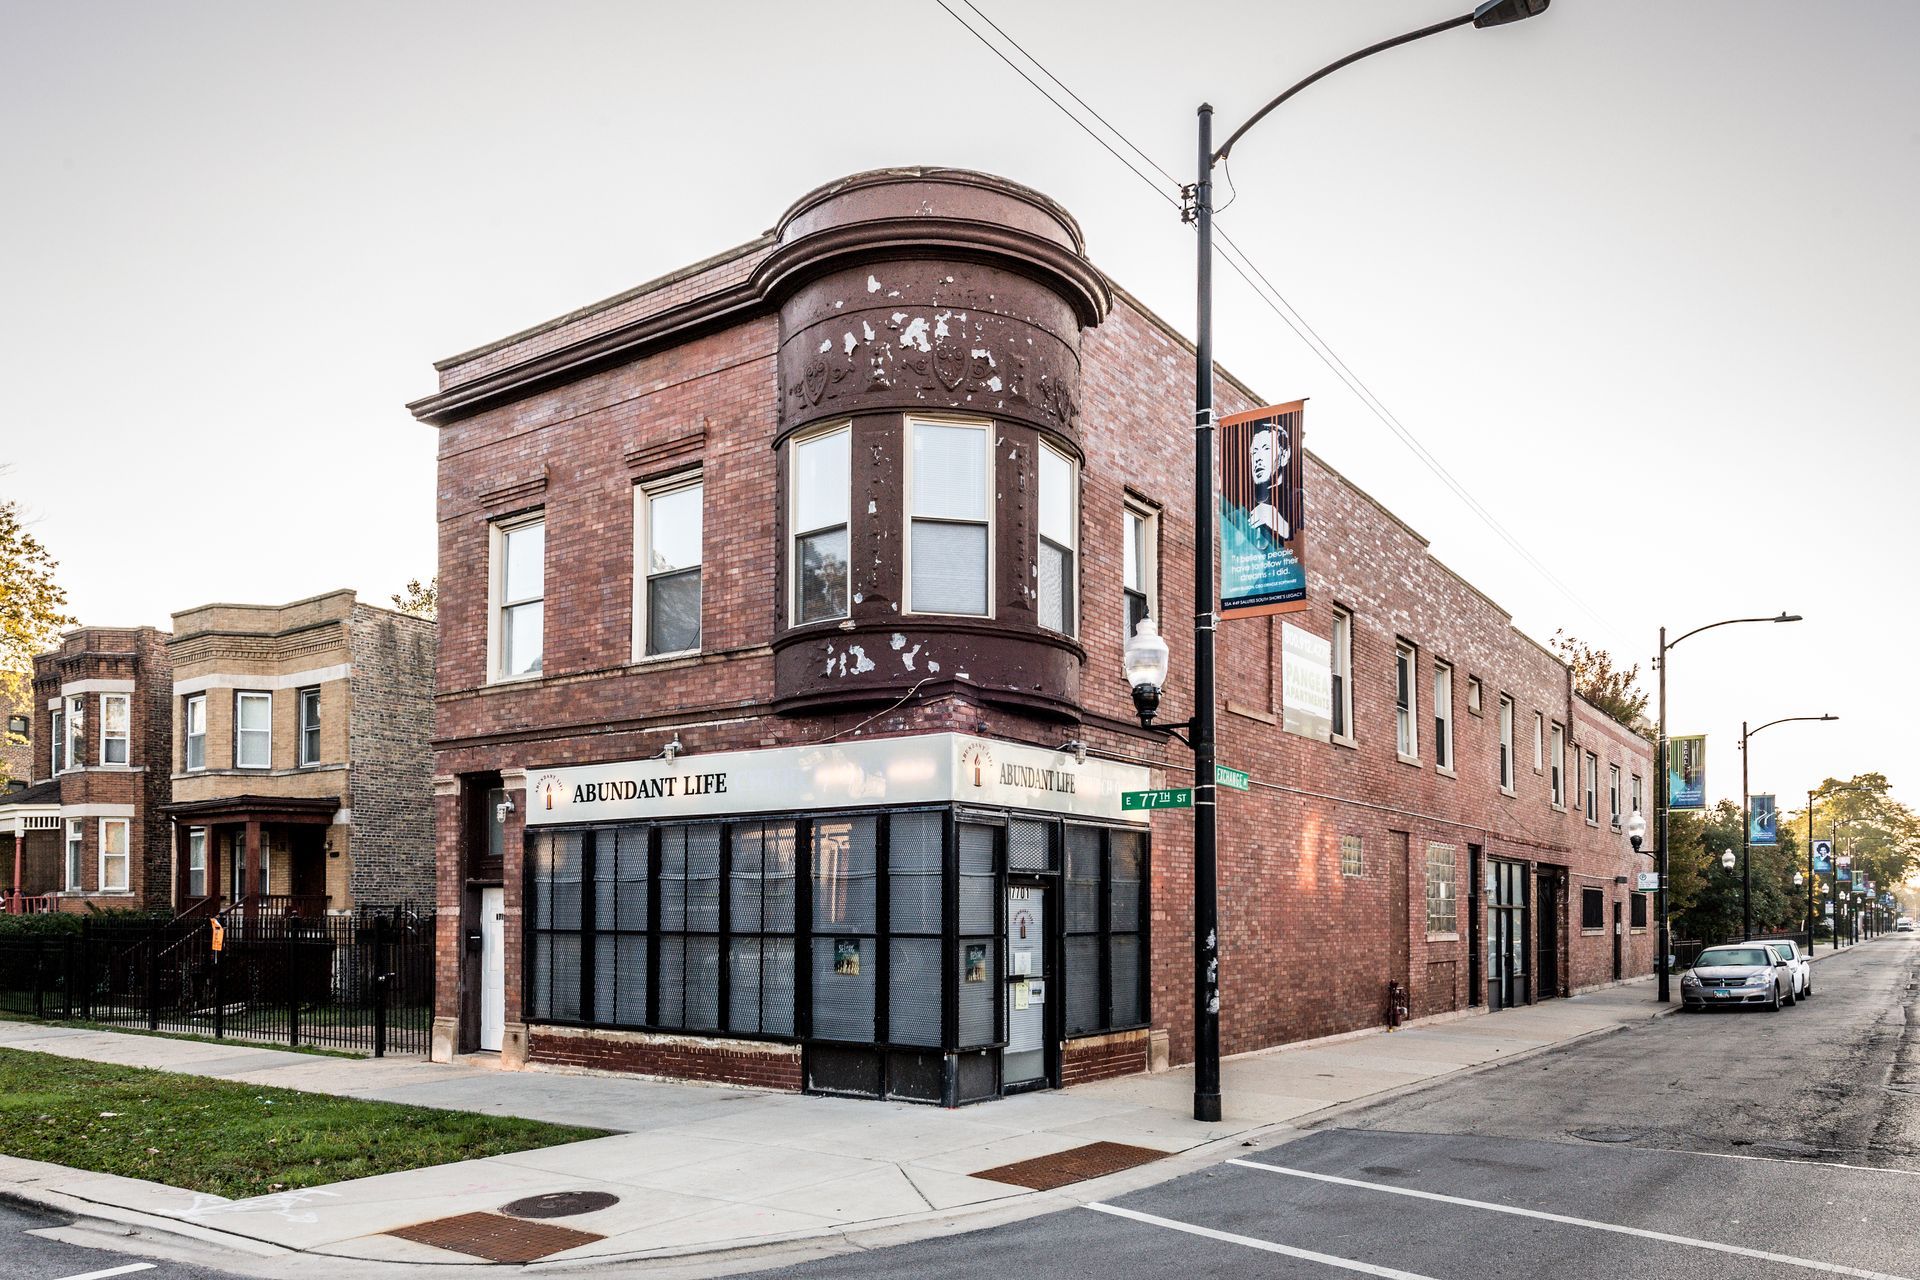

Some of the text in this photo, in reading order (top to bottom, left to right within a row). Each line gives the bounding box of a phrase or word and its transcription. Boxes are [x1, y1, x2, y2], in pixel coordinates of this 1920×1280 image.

[1267, 549, 1293, 559] people
[1232, 565, 1249, 574] have
[1259, 560, 1282, 569] follow
[1283, 557, 1298, 565] their
[1276, 567, 1291, 576] did.
[1285, 660, 1329, 696] PANGEA
[999, 762, 1055, 791] ABUNDANT
[1056, 771, 1076, 794] LIFE
[1216, 767, 1243, 788] EXCHANGE
[572, 777, 677, 803] ABUNDANT
[683, 773, 727, 796] LIFE
[1126, 796, 1132, 805] E
[1176, 794, 1187, 803] ST
[1011, 886, 1029, 899] 7701
